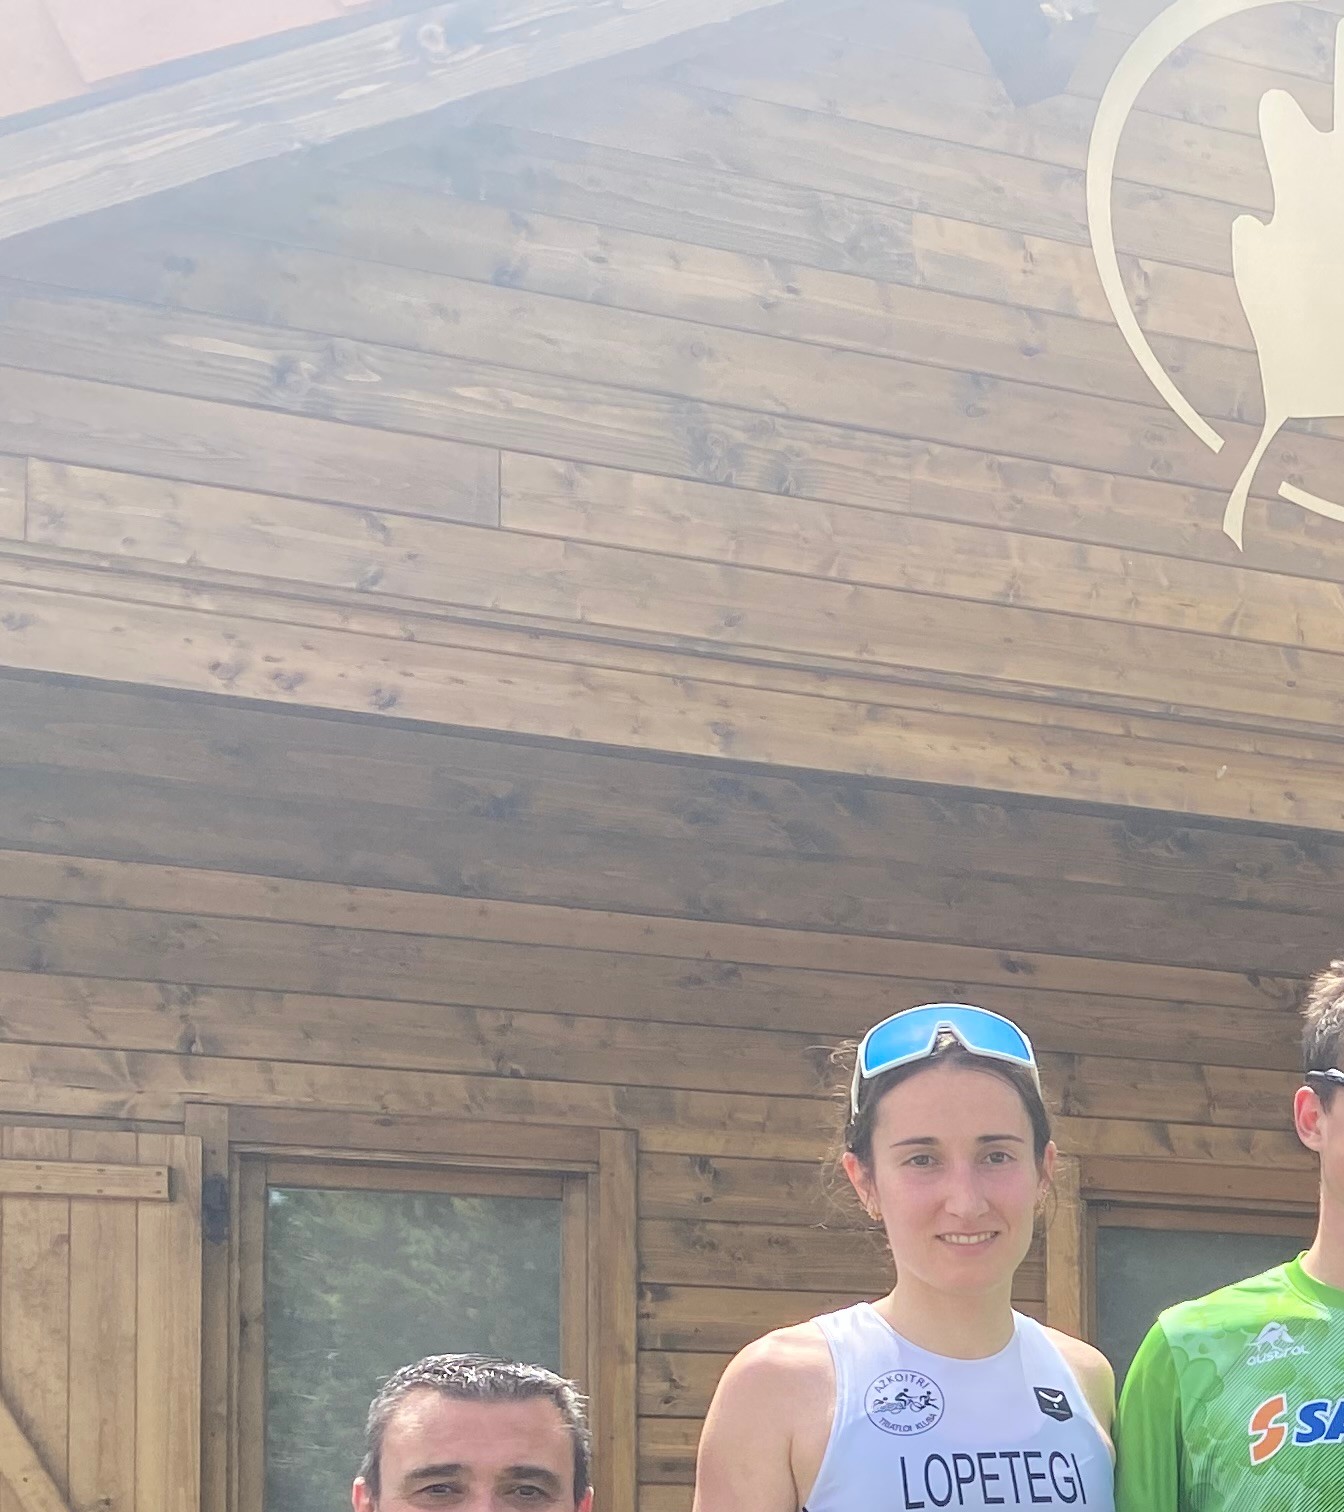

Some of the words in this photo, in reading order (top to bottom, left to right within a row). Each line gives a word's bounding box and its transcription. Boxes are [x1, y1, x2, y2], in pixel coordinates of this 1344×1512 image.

[1247, 1345, 1310, 1366] austral
[874, 1373, 930, 1393] AZKOITRI
[900, 1451, 1087, 1510] LOPETEGI
